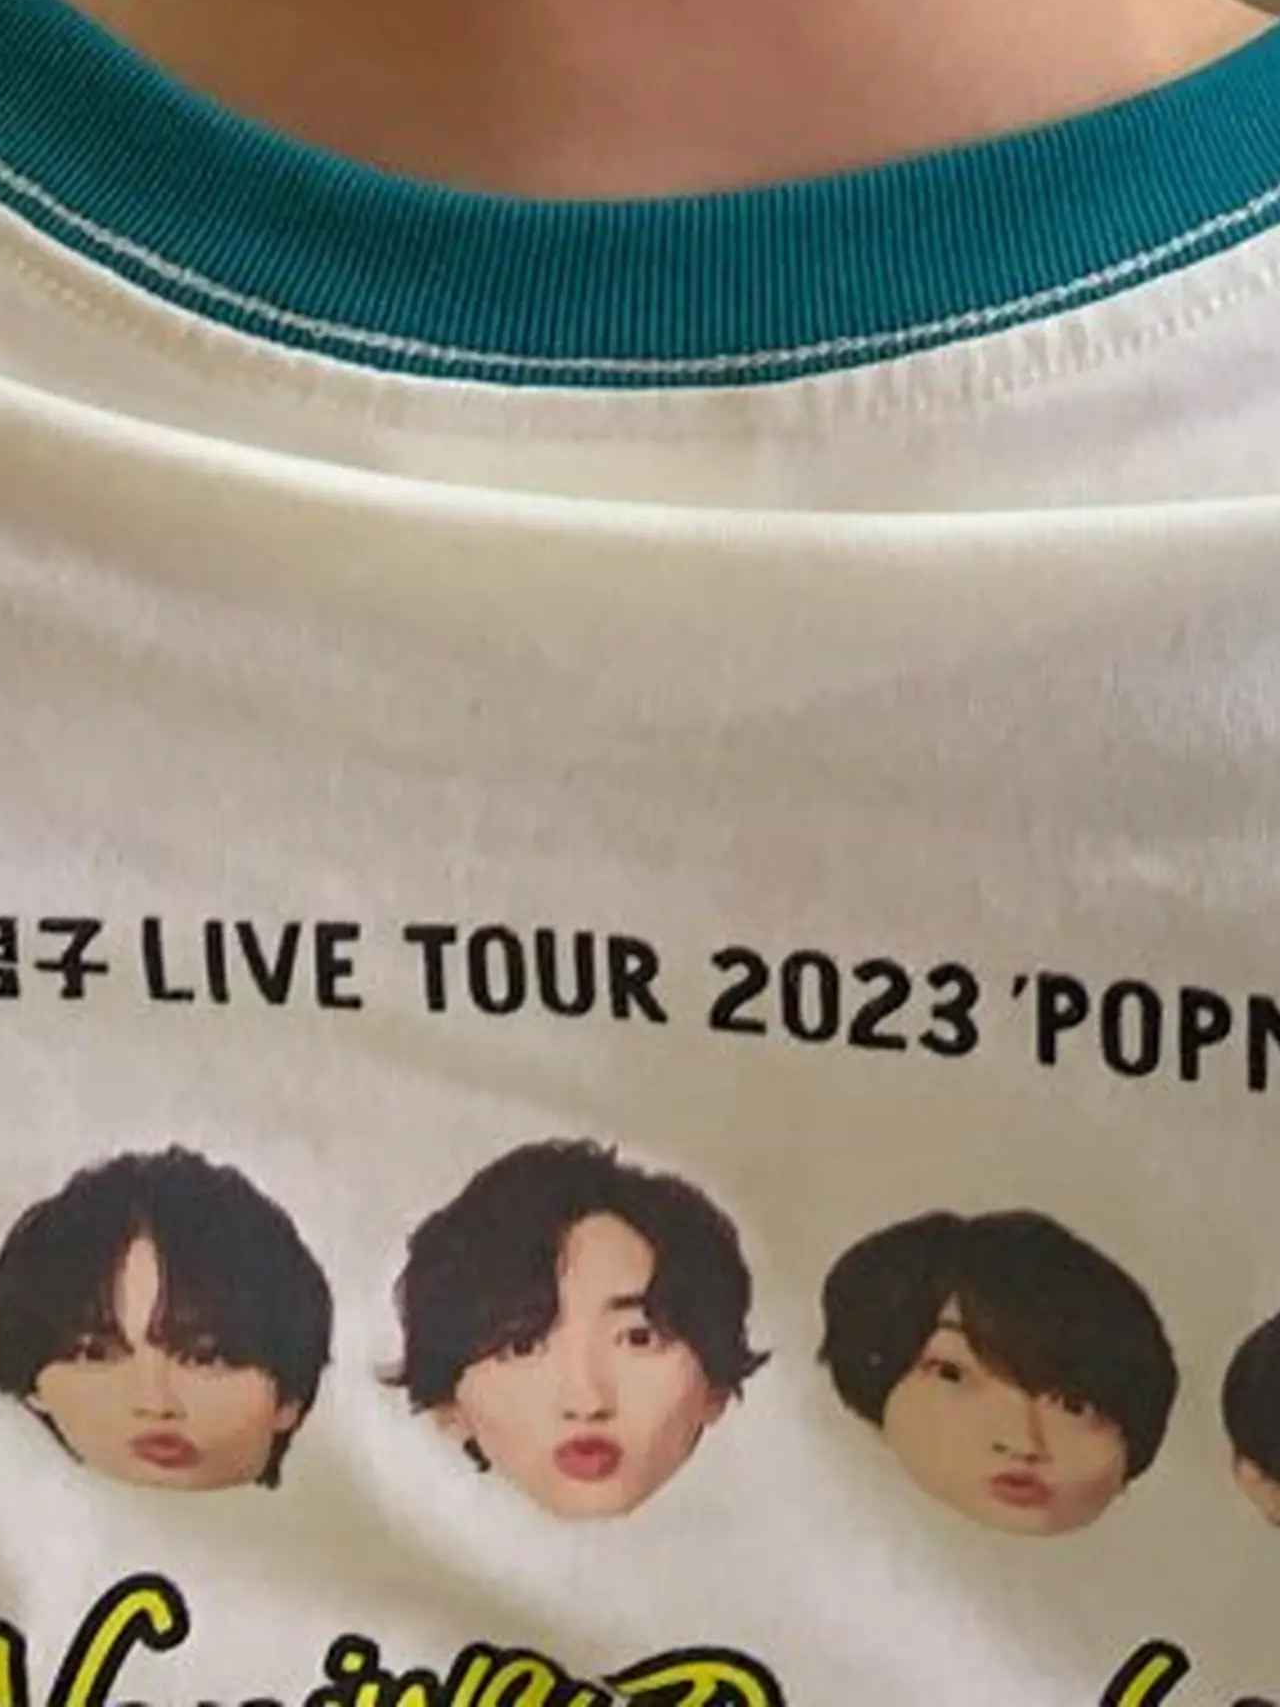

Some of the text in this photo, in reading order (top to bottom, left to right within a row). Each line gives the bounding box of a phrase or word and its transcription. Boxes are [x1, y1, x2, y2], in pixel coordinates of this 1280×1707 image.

[142, 916, 364, 1010] LIVE
[402, 924, 669, 1025] TOUR
[707, 946, 981, 1058] 2023
